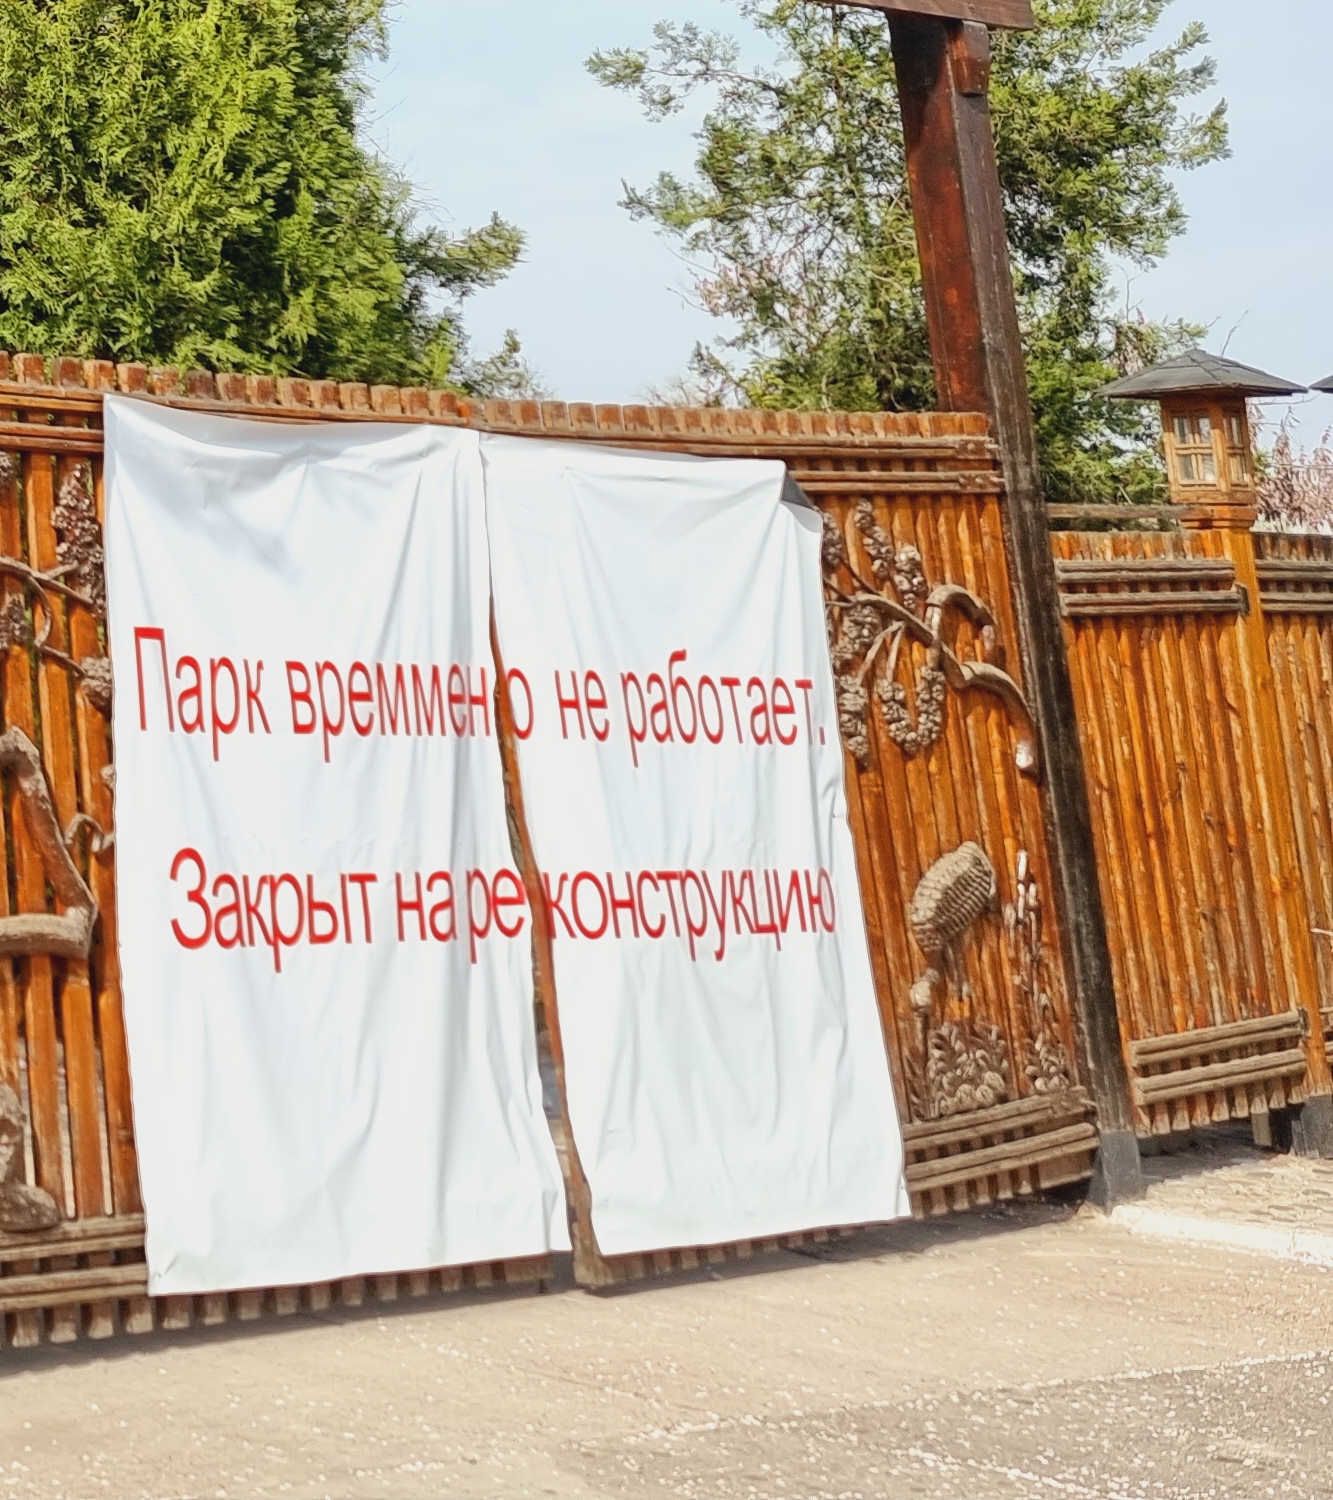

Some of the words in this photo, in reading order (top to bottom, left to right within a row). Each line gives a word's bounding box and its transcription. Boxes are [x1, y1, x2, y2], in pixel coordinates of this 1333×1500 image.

[134, 626, 272, 762] Парк
[554, 669, 610, 741] не
[621, 648, 826, 767] работает.
[170, 847, 377, 973] Закрыт
